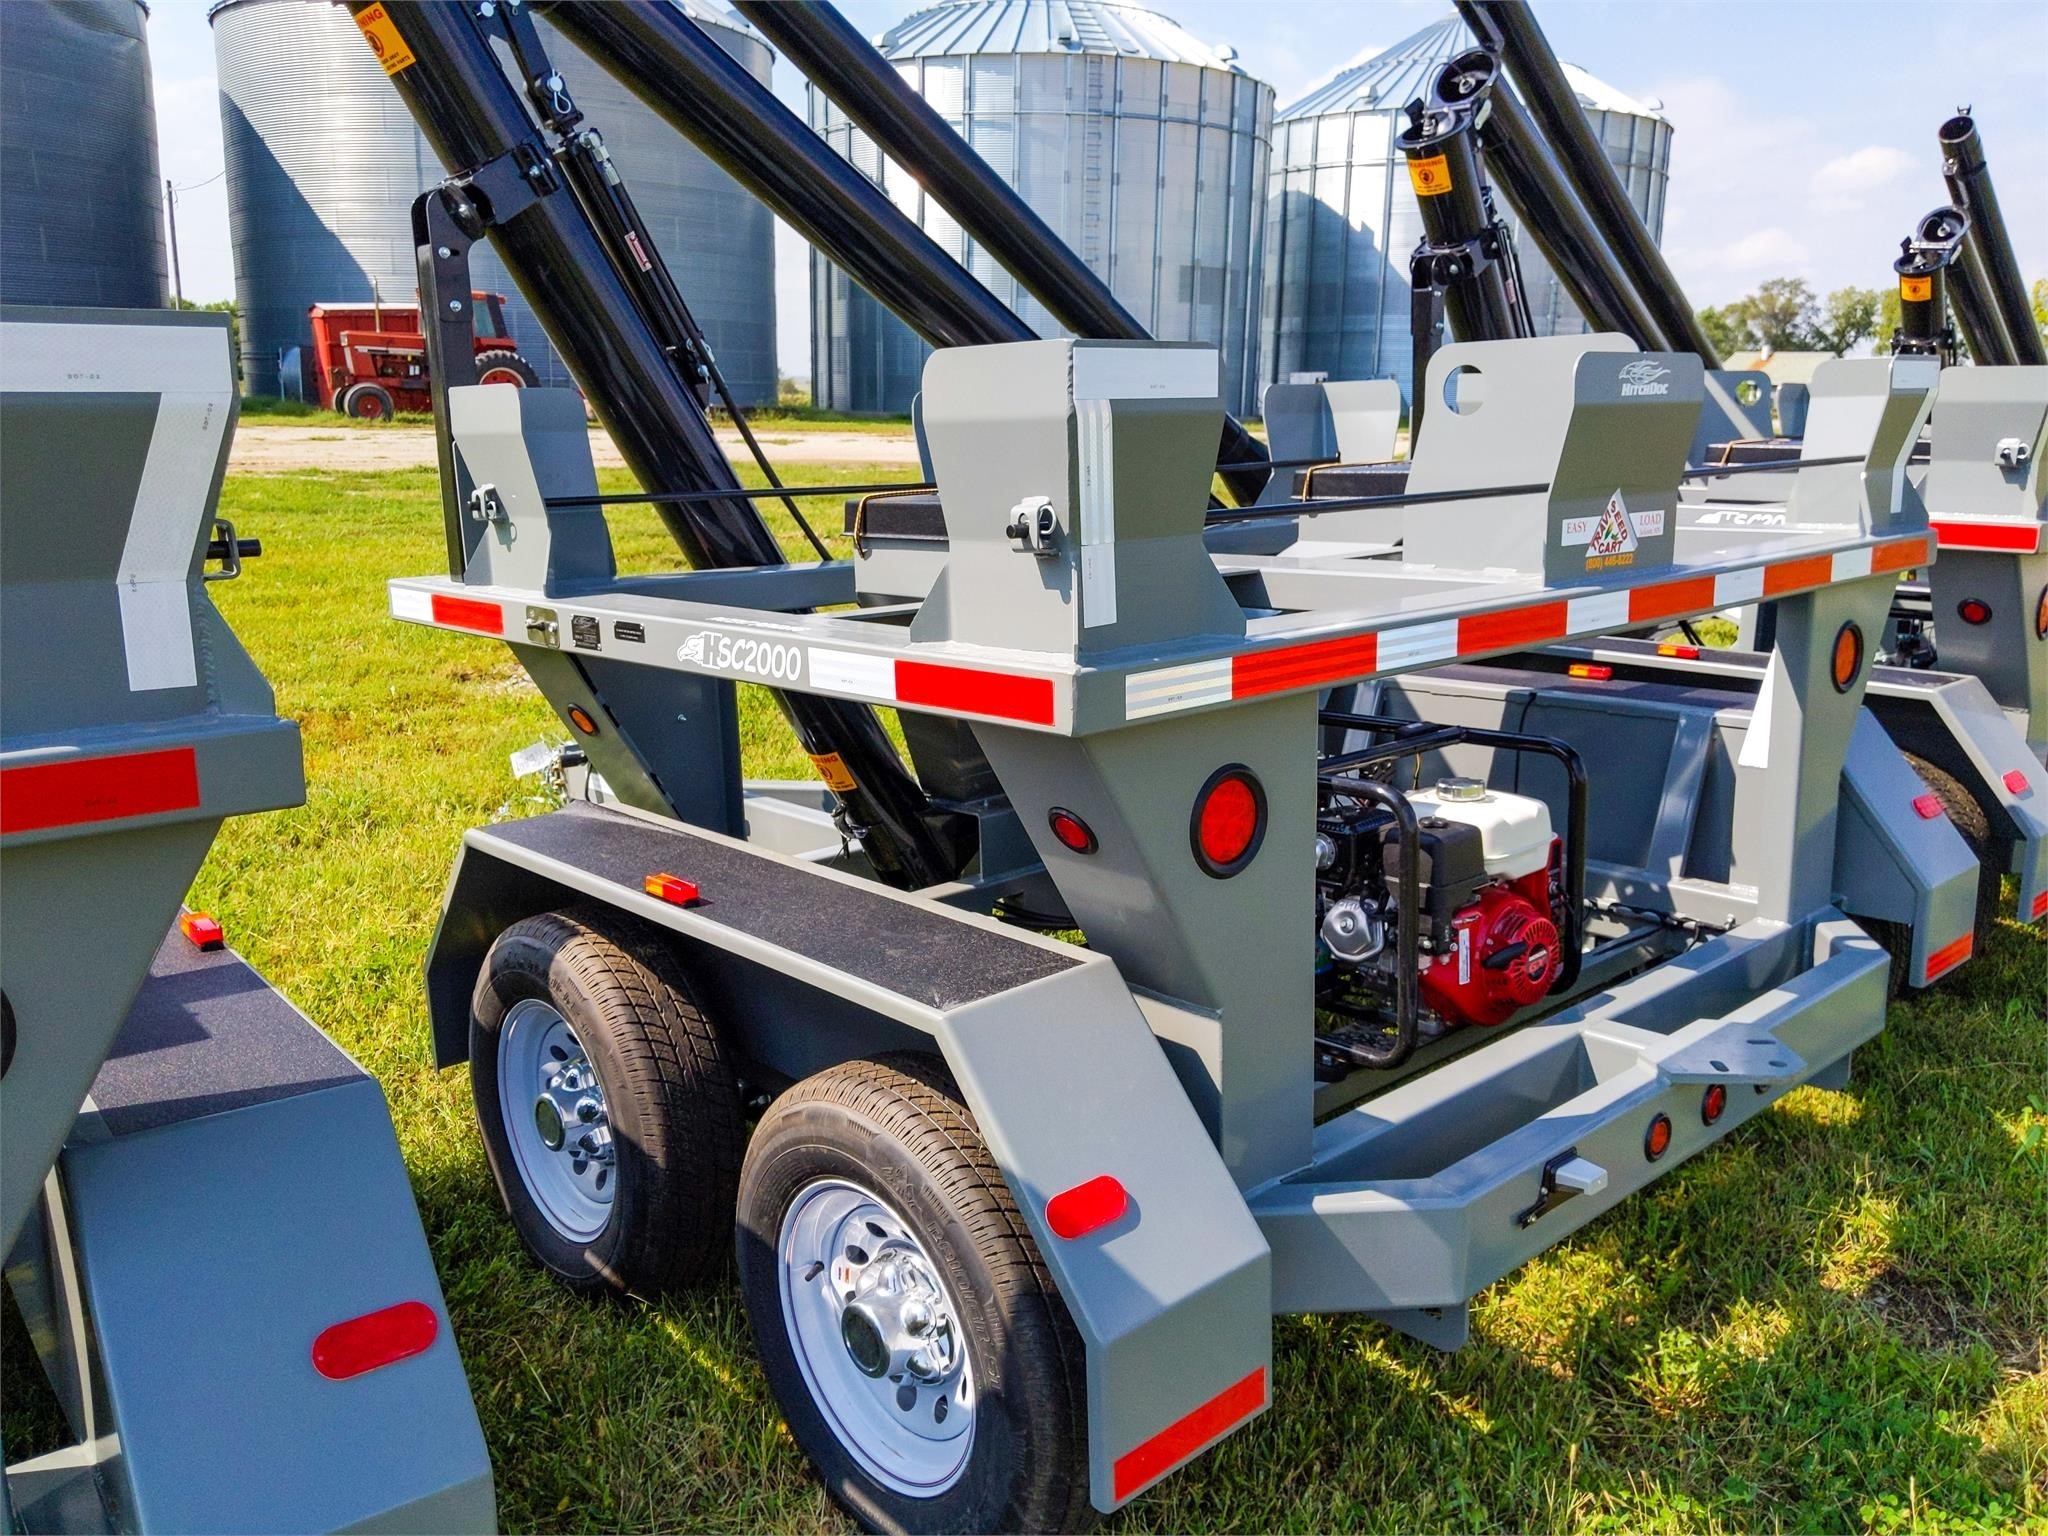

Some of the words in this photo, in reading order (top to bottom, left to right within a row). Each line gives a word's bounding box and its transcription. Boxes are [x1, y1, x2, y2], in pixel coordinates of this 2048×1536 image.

[1566, 520, 1588, 535] EASY
[1640, 512, 1662, 527] LOAD
[1598, 540, 1624, 554] CART
